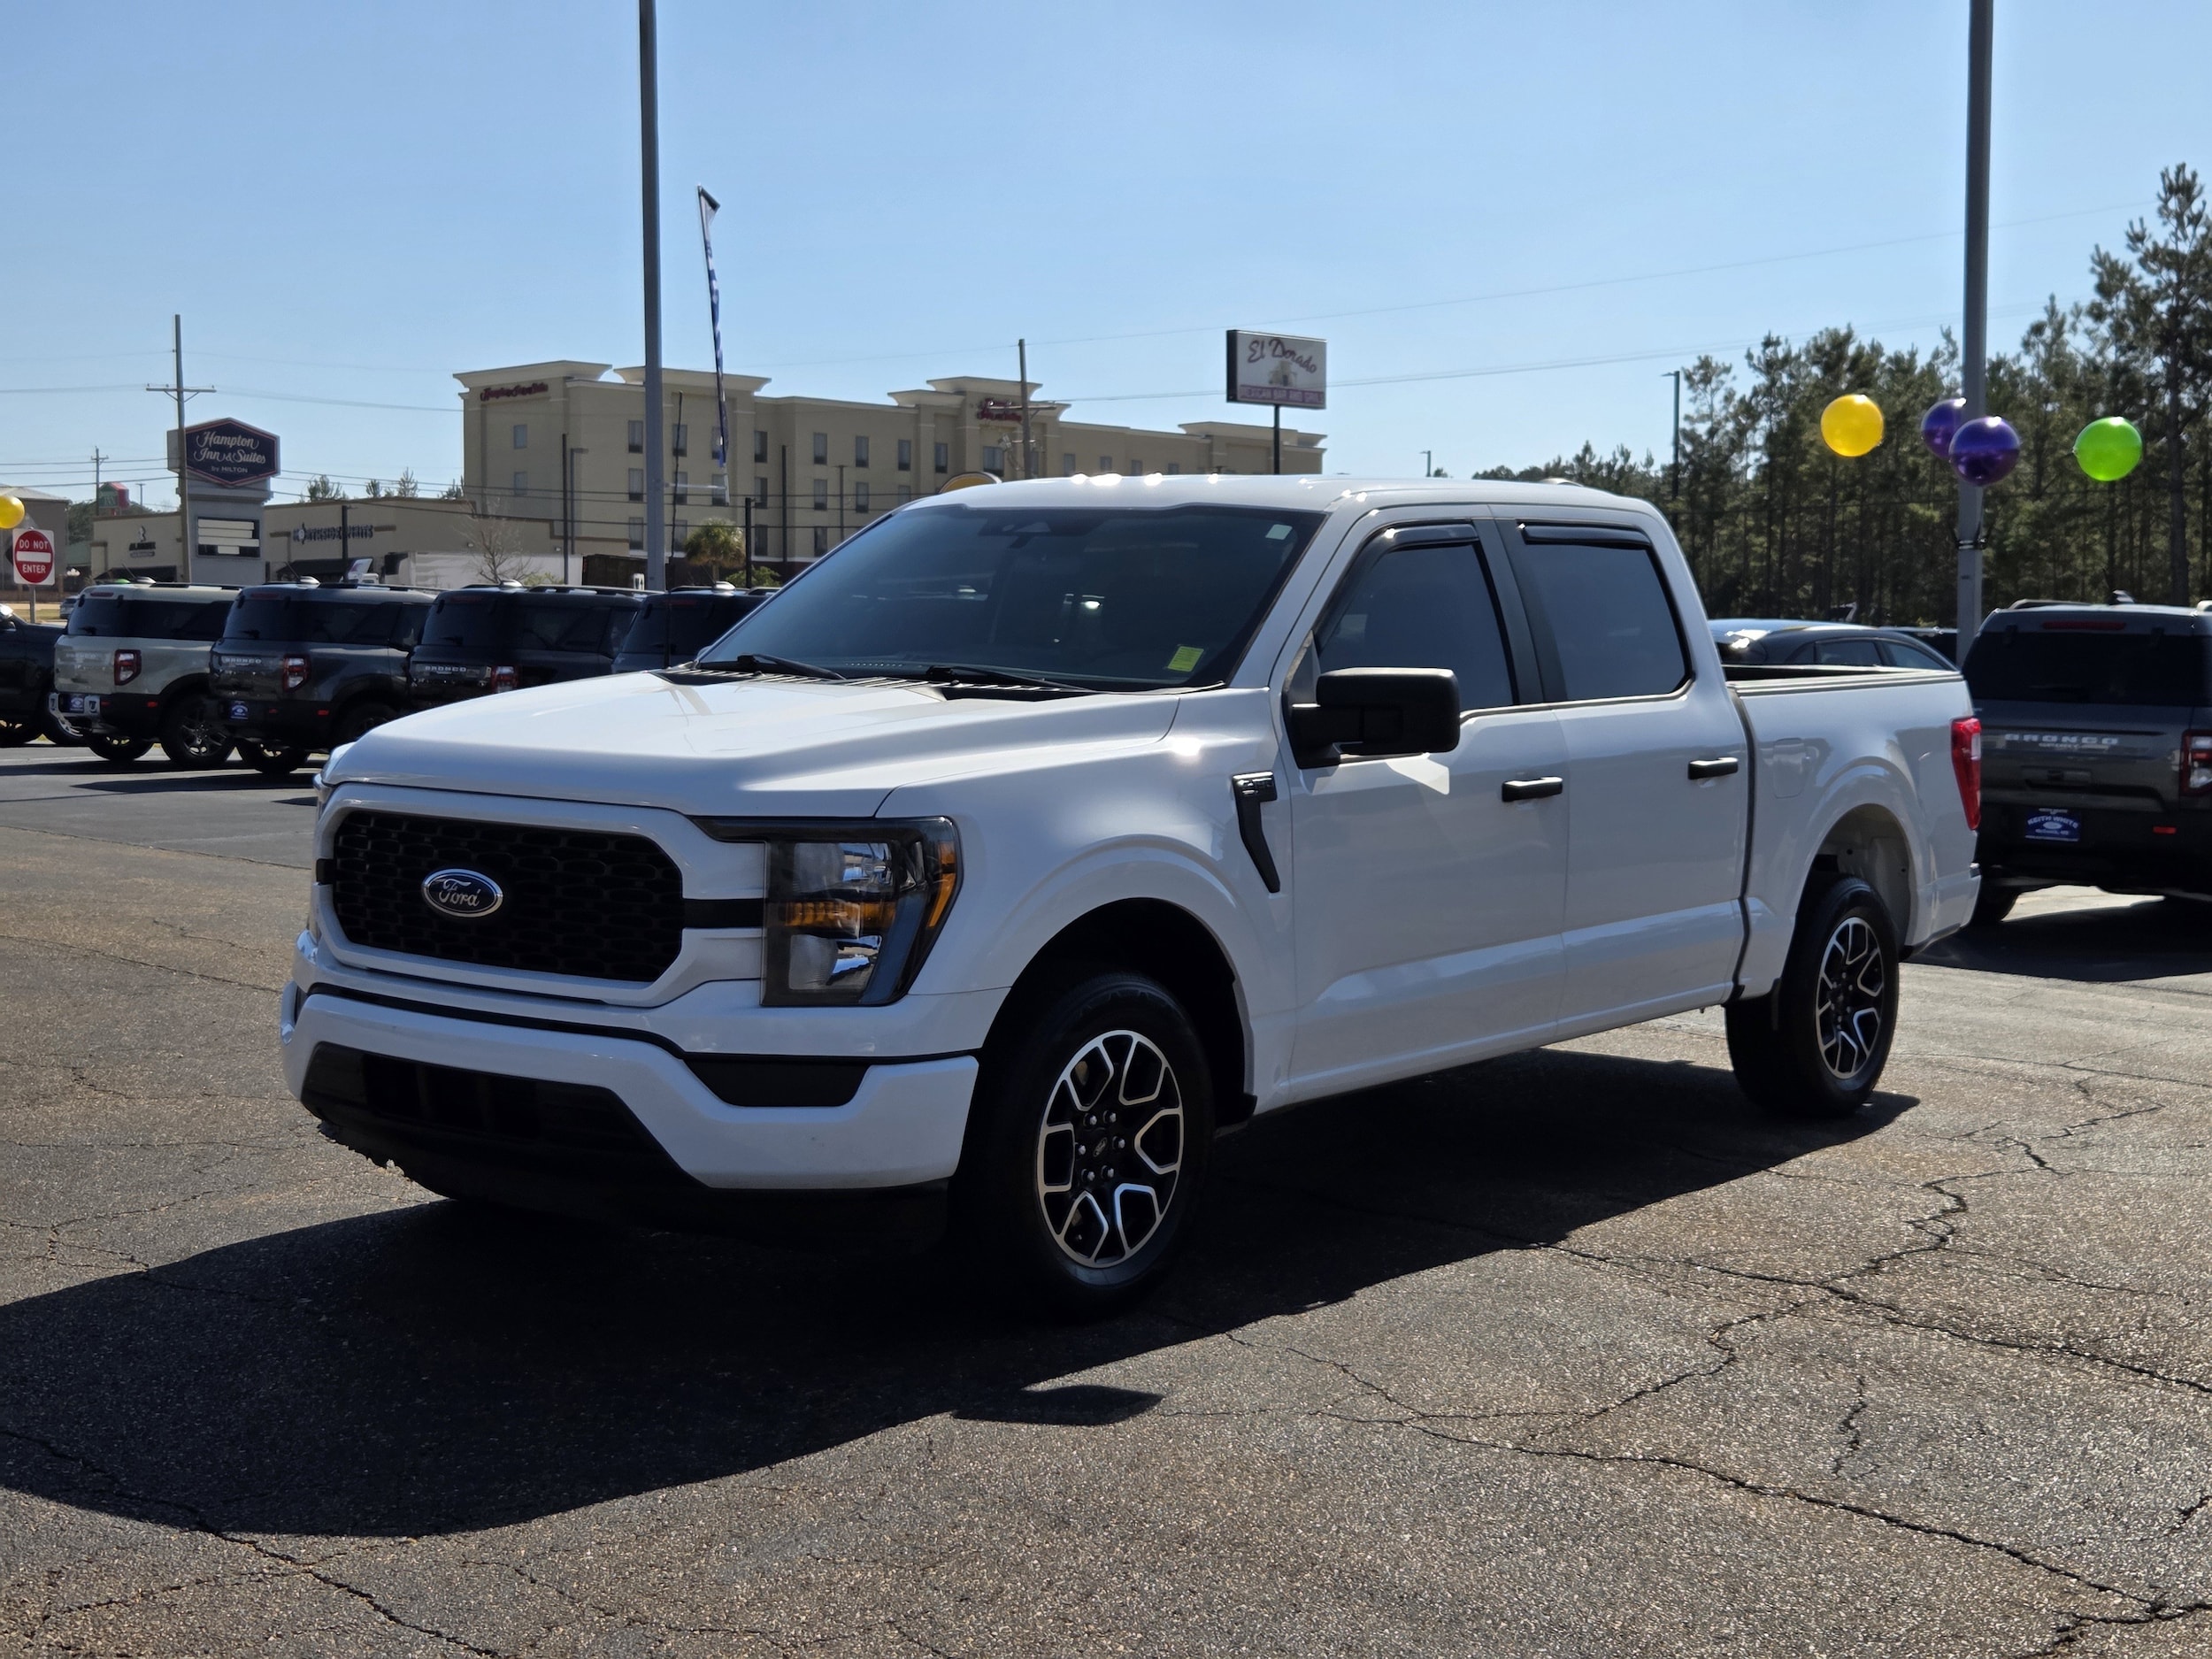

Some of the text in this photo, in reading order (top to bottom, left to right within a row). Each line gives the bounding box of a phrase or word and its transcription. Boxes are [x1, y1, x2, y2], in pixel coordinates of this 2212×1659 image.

[1248, 338, 1317, 373] El Dorado
[196, 431, 259, 449] Hampton
[193, 448, 226, 462] Inn
[233, 449, 265, 465] Suites
[19, 539, 48, 550] DO NOT
[22, 564, 46, 574] ENTER
[2004, 733, 2118, 746] BRONCO
[437, 878, 481, 908] Ford
